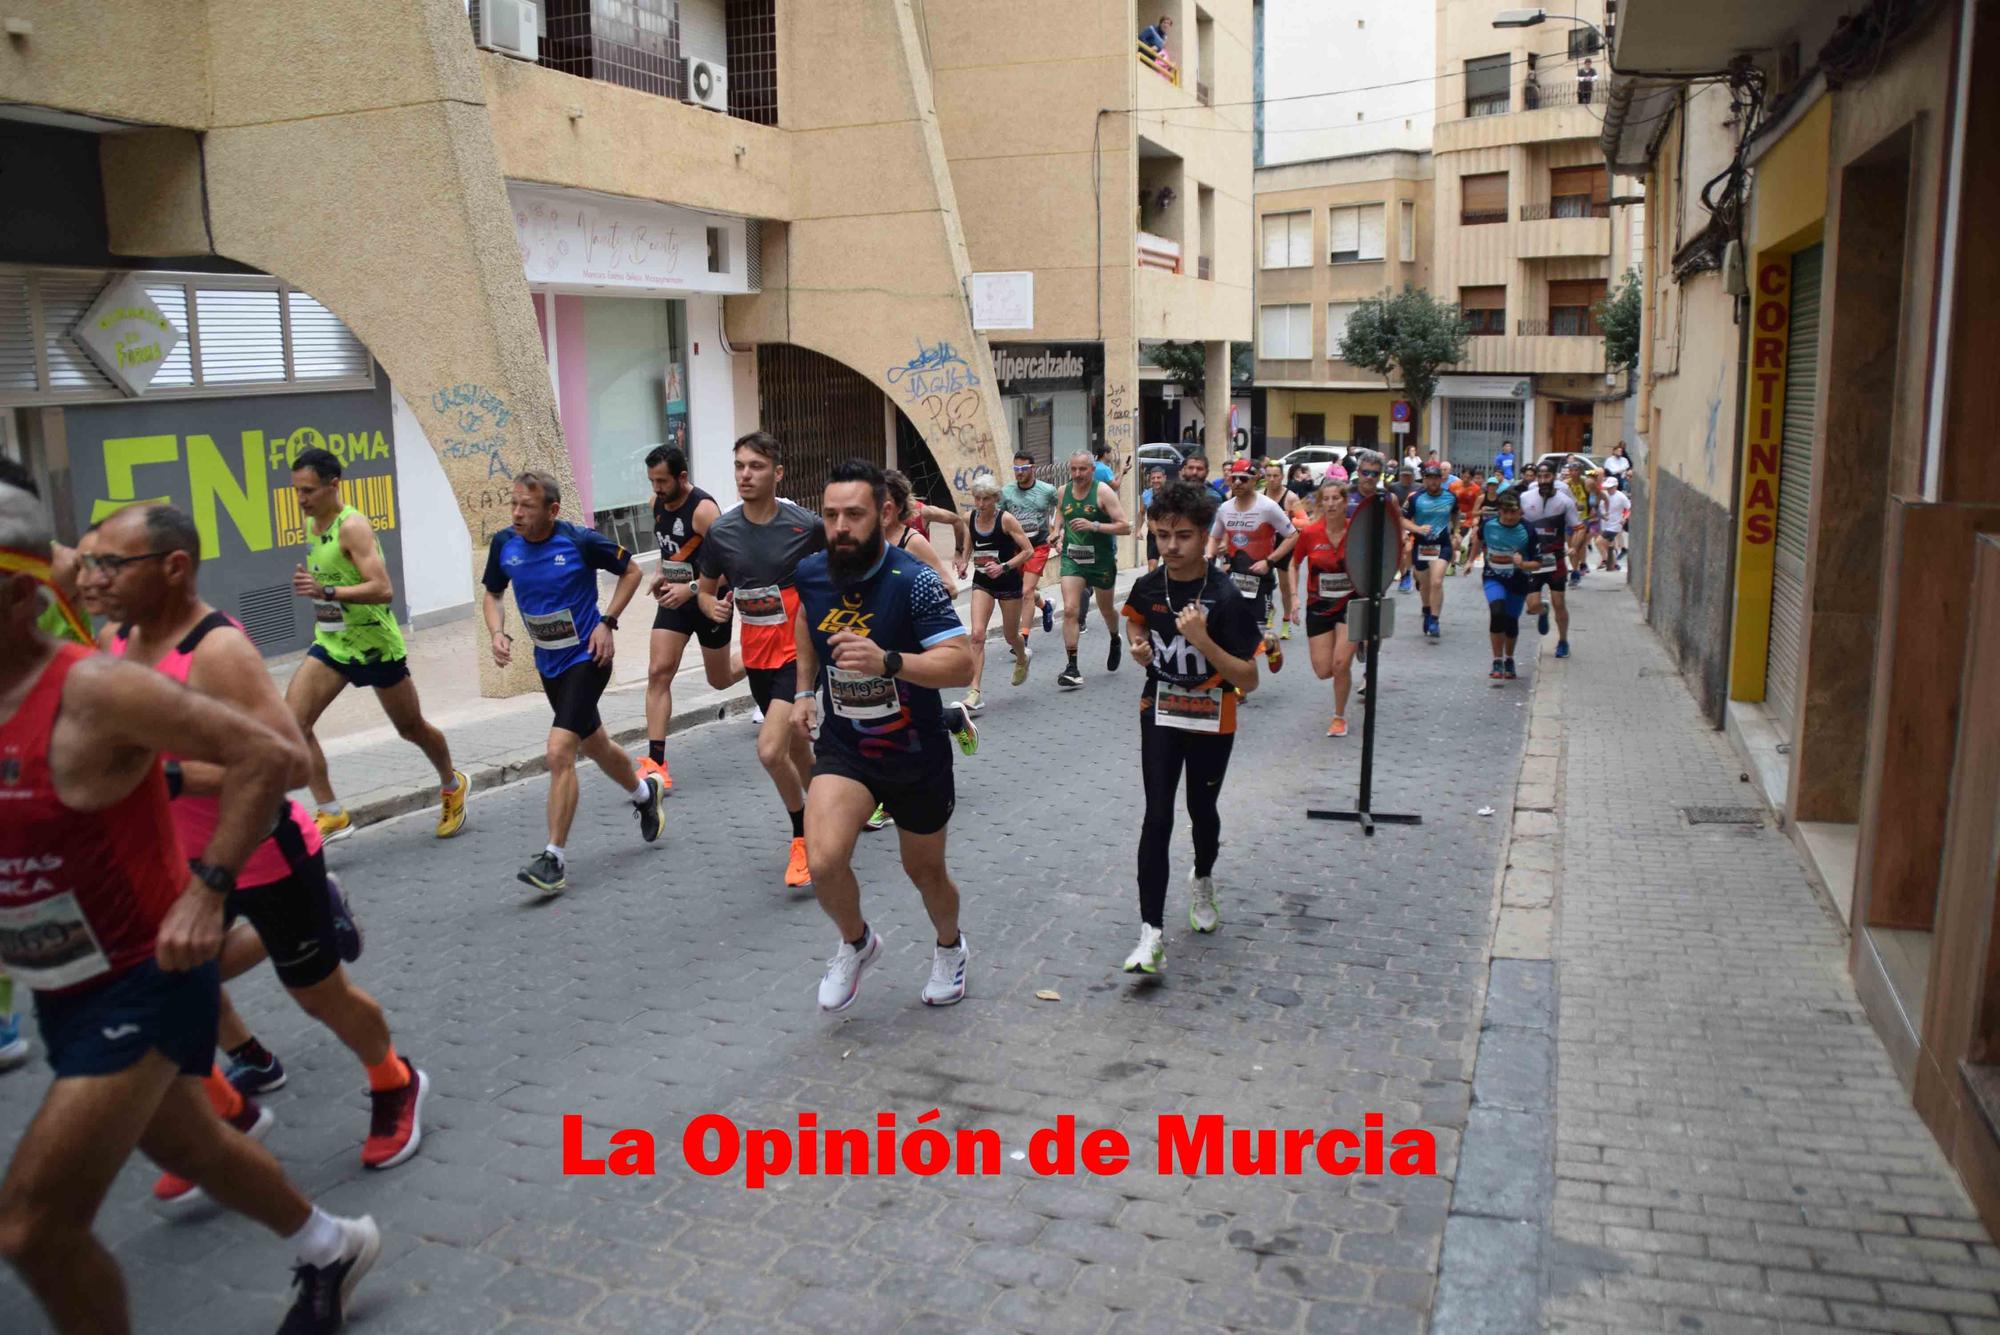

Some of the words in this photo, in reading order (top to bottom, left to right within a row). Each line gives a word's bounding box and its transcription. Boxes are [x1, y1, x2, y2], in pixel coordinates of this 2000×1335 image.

[992, 349, 1084, 387] Hipercalzados
[1745, 264, 1787, 544] CORTINAS
[269, 426, 390, 470] FORMA
[838, 679, 888, 698] 1195
